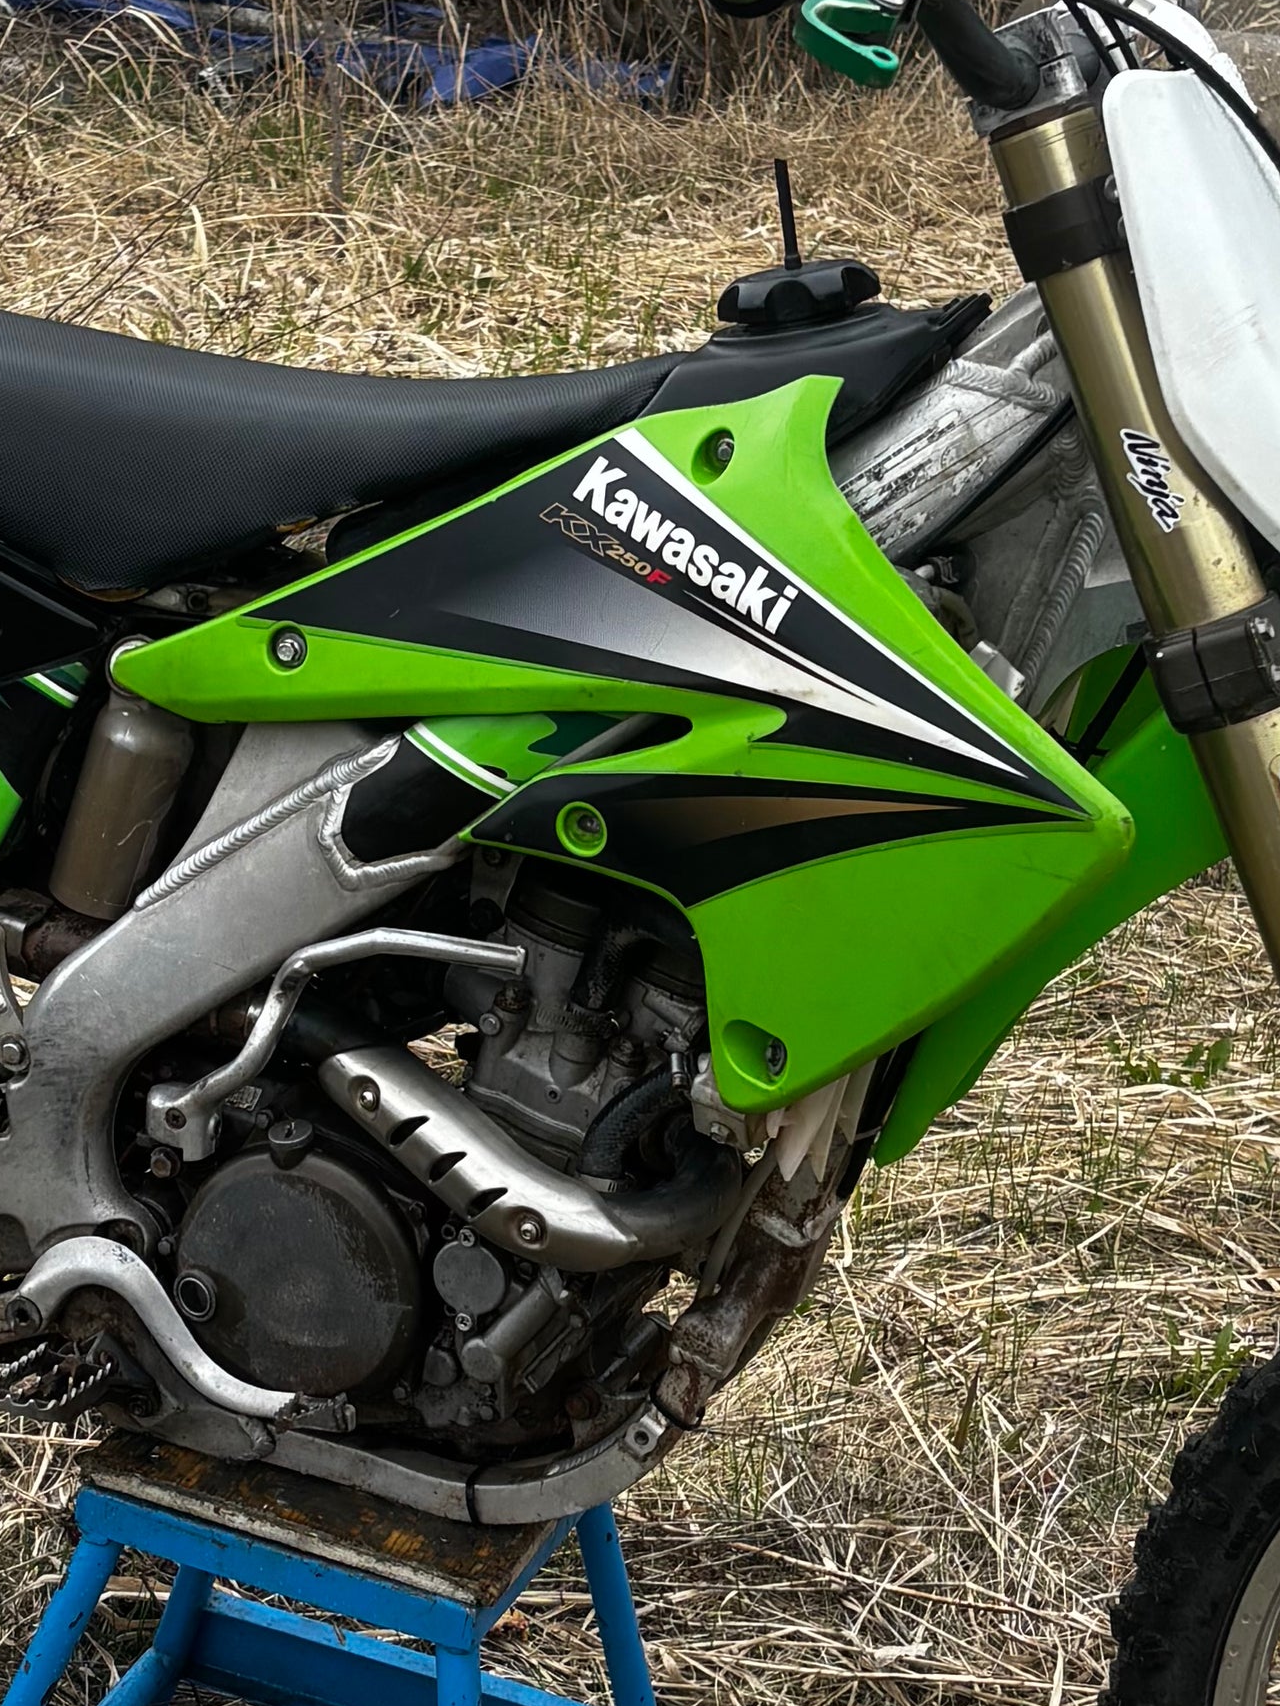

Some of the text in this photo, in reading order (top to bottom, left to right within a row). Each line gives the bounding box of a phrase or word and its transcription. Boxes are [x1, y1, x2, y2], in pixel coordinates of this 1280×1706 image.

[1121, 429, 1184, 532] Ninja
[539, 502, 672, 585] KX250F
[572, 455, 799, 635] Kawasaki
